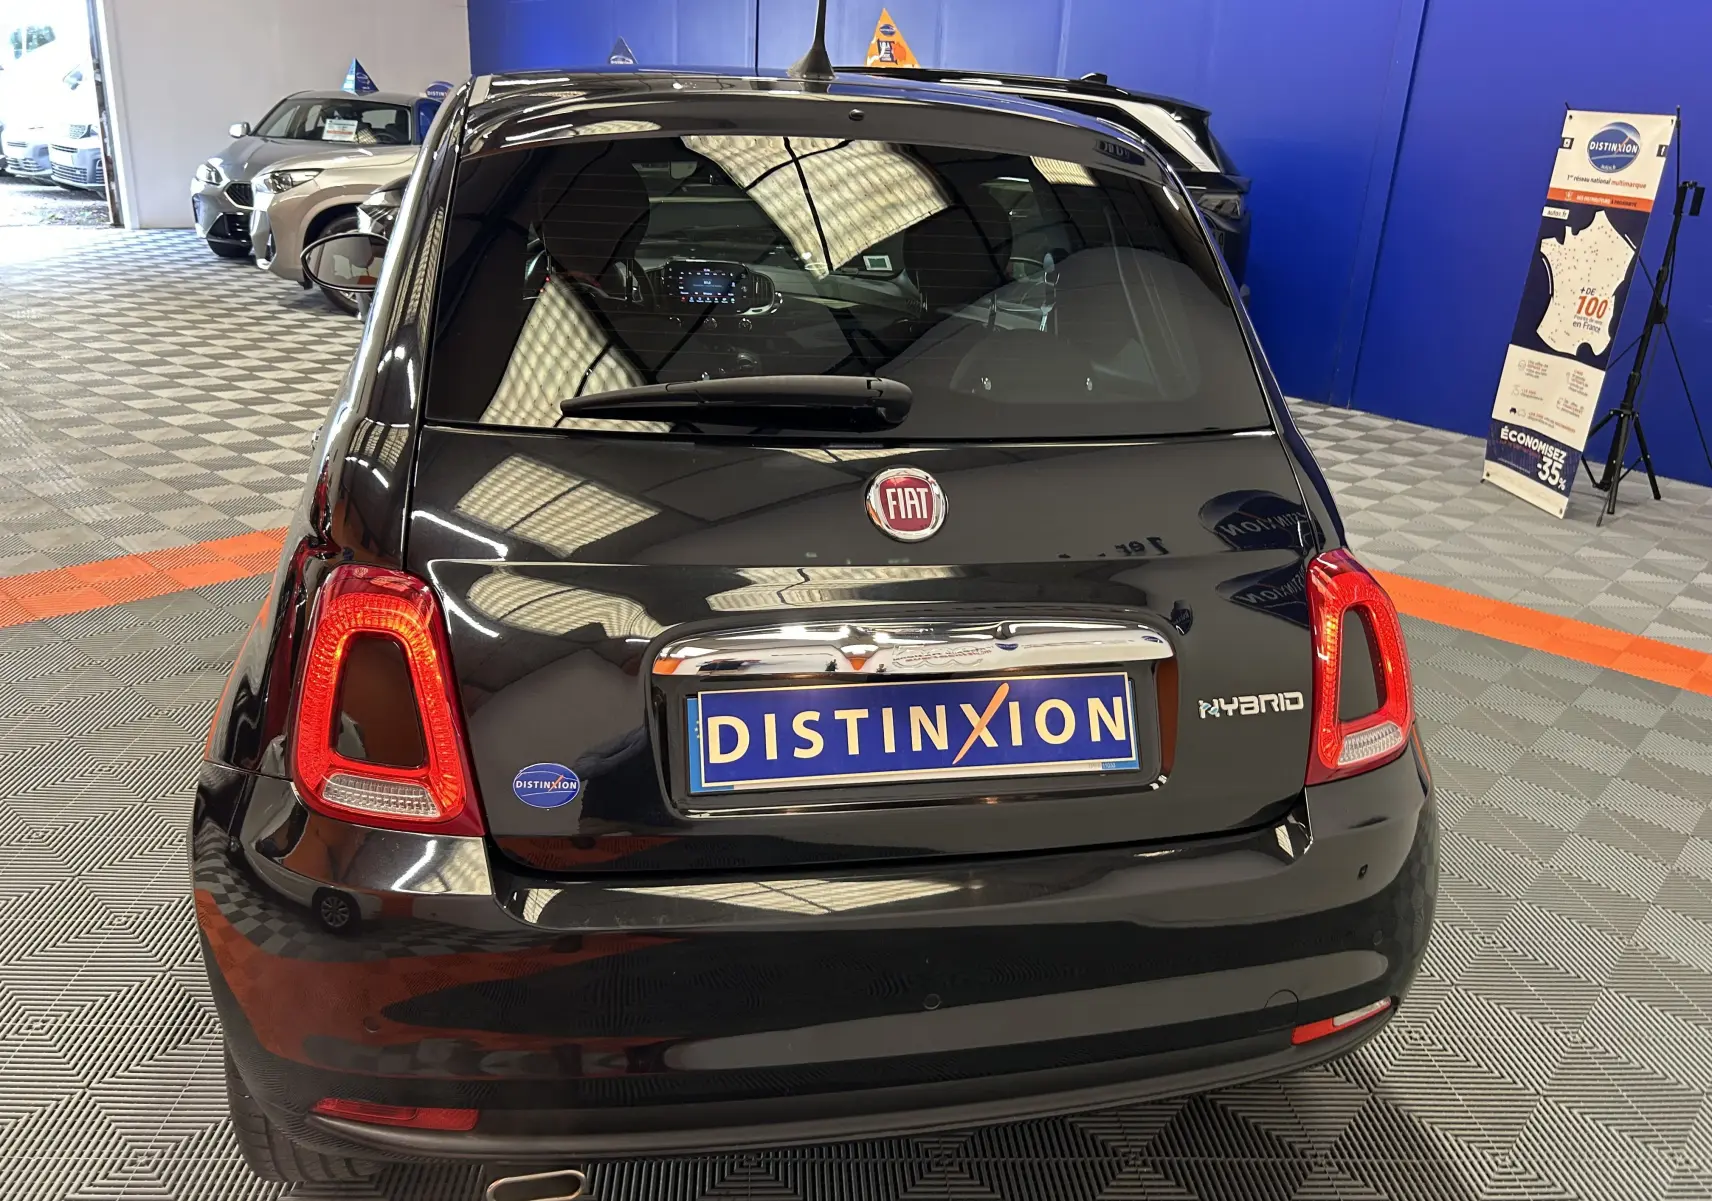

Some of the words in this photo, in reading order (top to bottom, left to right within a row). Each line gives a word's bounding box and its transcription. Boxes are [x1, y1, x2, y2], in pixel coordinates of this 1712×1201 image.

[1589, 138, 1639, 154] DISTINXION
[1591, 177, 1611, 185] national
[1611, 180, 1647, 189] multimarque
[1576, 295, 1608, 319] 100
[1583, 322, 1601, 334] France
[1500, 426, 1567, 463] ÉCONOMISEZ
[886, 487, 929, 520] FIAT
[1198, 691, 1304, 719] HYBRID
[706, 682, 1127, 764] DISTINXION
[515, 777, 577, 791] DISTINXION
